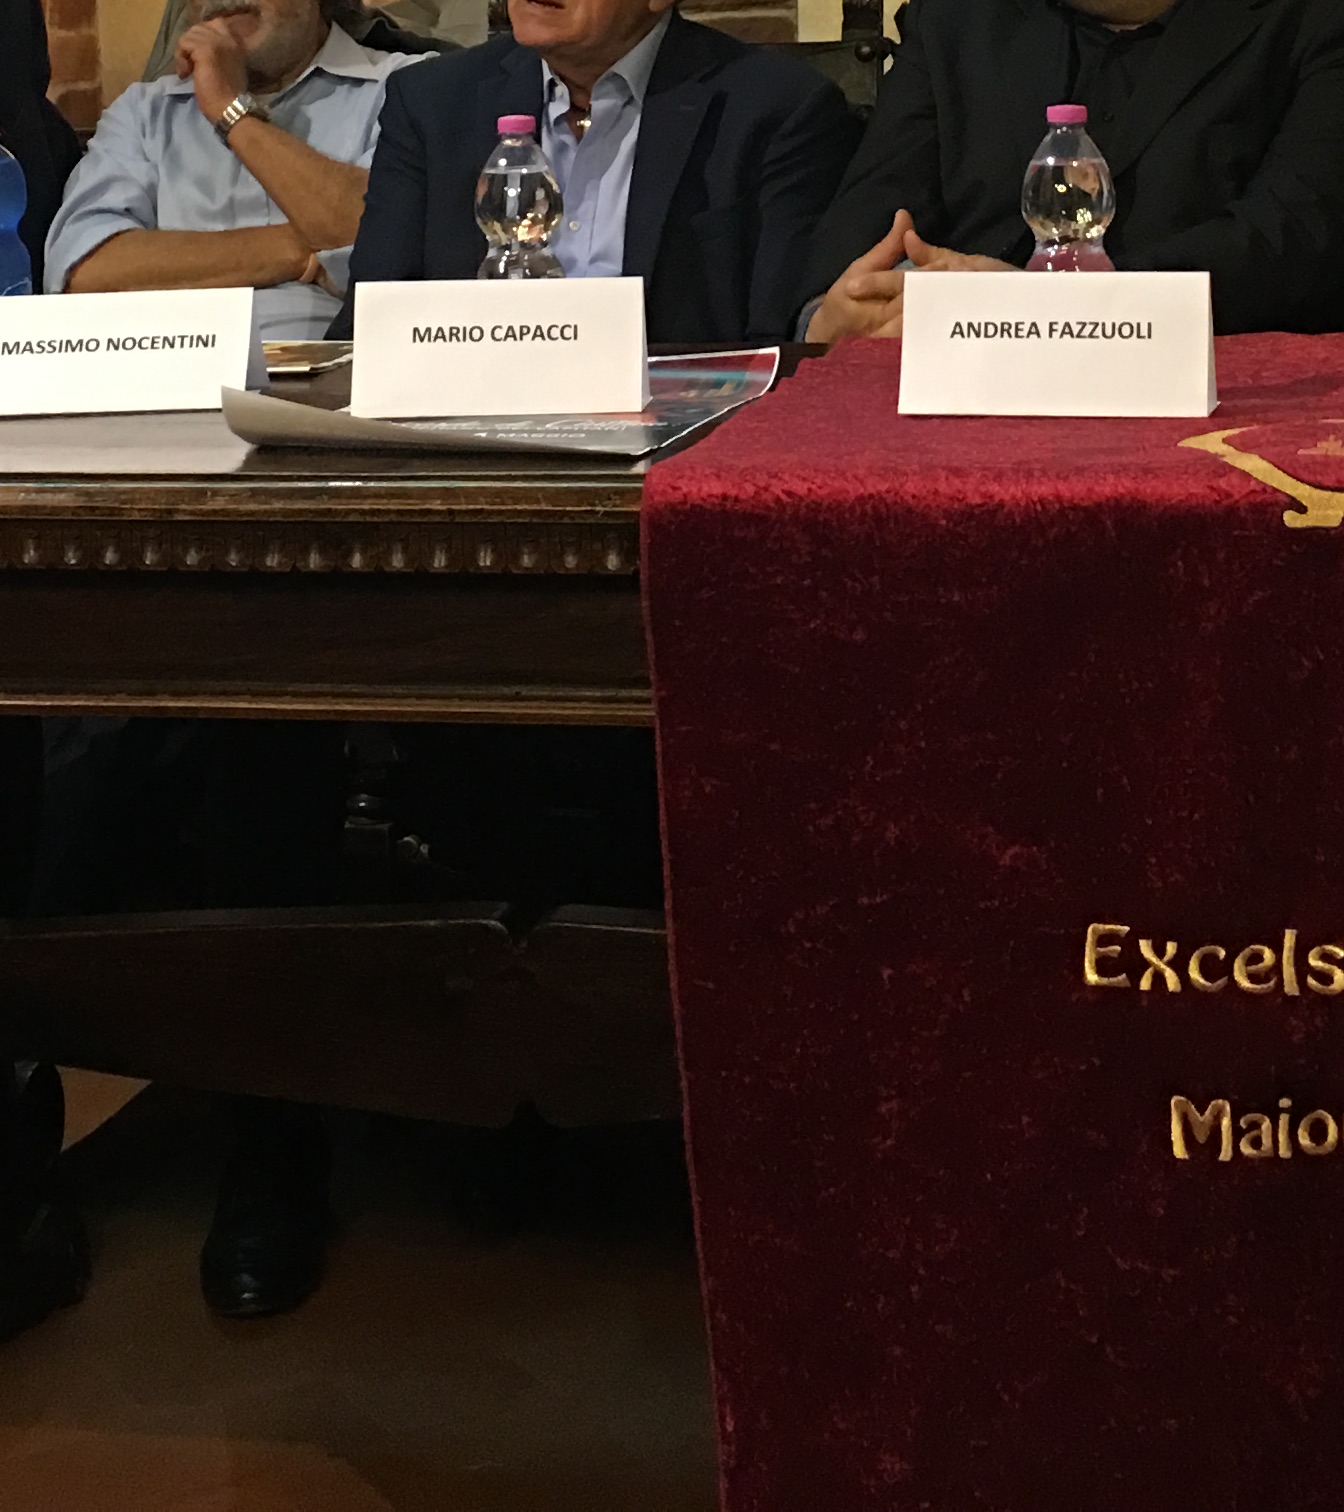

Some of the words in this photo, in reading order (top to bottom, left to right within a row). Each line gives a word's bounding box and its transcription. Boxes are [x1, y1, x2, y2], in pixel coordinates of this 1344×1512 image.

[412, 325, 485, 344] MARIO
[490, 324, 578, 342] CAPACCI
[950, 321, 1041, 339] ANDREA
[1048, 321, 1152, 340] FAZZUOLI
[1, 338, 100, 356] MASSIMO
[106, 334, 216, 351] NOCENTINI
